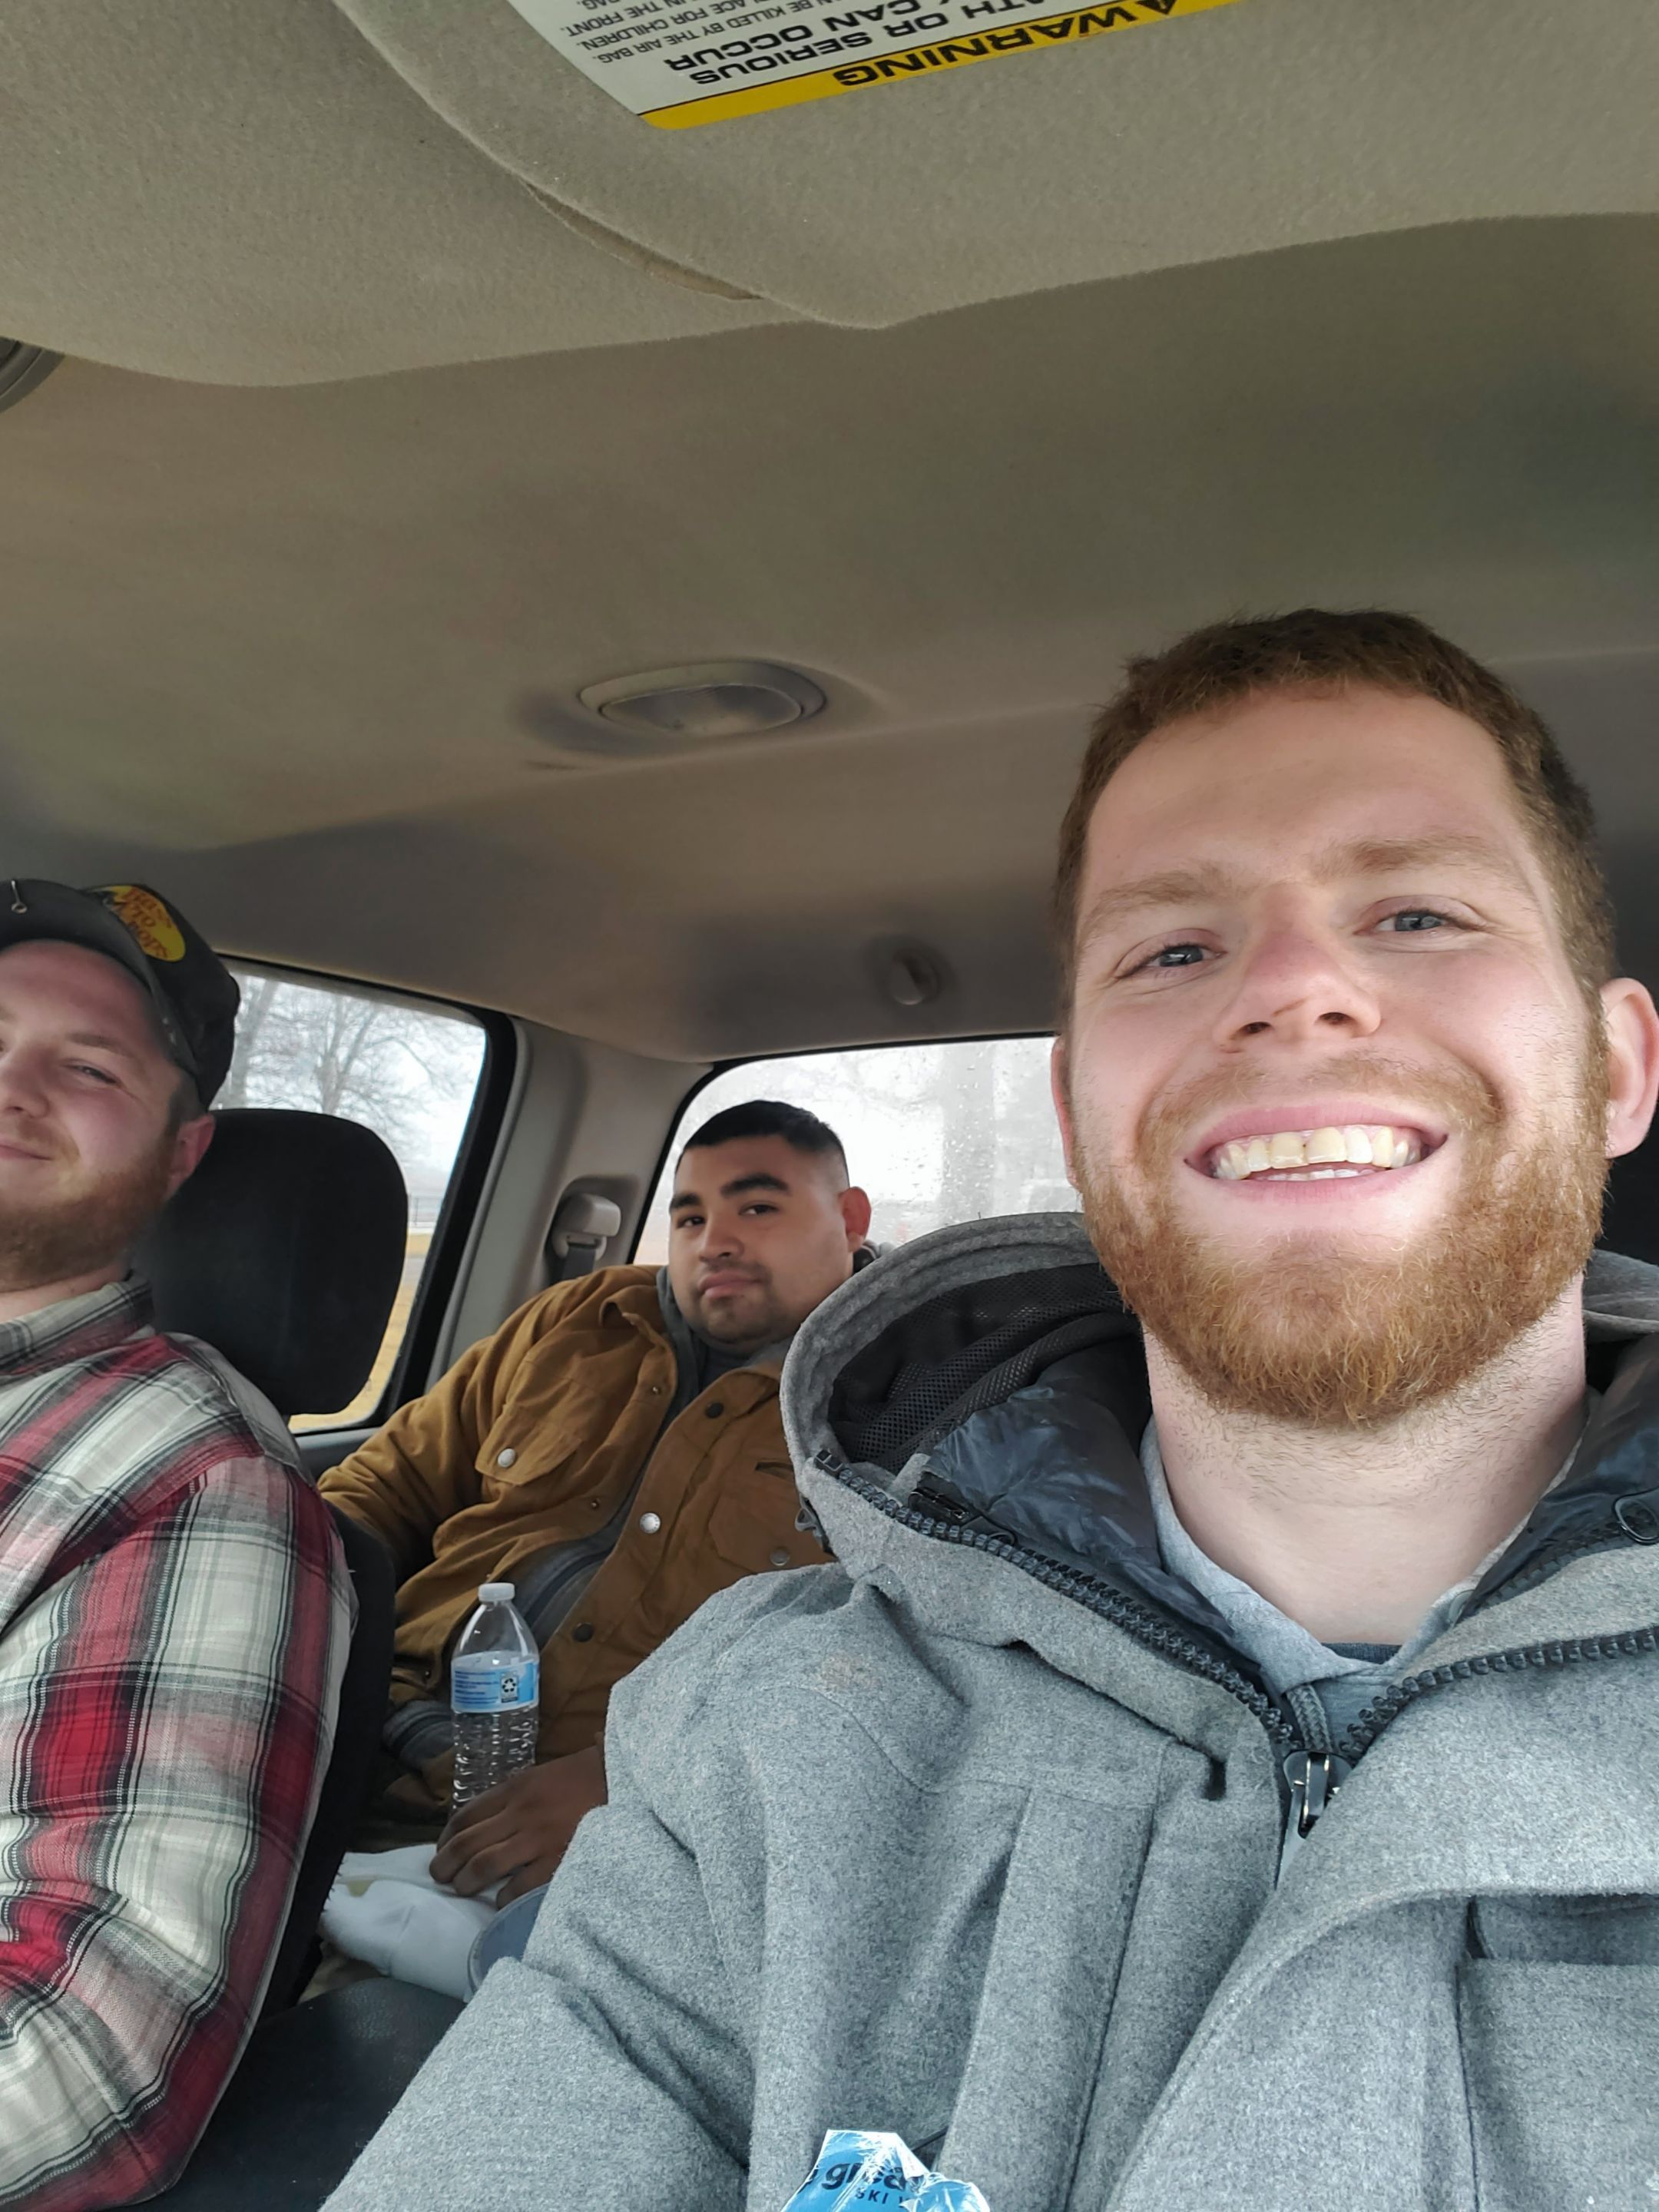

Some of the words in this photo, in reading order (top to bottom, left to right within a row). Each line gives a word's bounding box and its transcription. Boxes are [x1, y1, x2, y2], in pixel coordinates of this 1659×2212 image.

[624, 2, 663, 18] THE
[670, 8, 708, 24] FOR
[726, 6, 786, 28] KILLED
[786, 1, 814, 13] BE
[823, 0, 921, 31] CAN
[560, 12, 624, 37] FRONT.
[576, 19, 669, 50] CHILDREN.
[701, 22, 724, 35] BY
[882, 12, 949, 37] OR
[632, 38, 662, 52] AIR
[663, 30, 700, 45] THE
[664, 25, 813, 71] OCCUR
[833, 6, 1138, 85] WARNING
[592, 48, 634, 63] BAG.
[690, 31, 873, 84] SERIOUS
